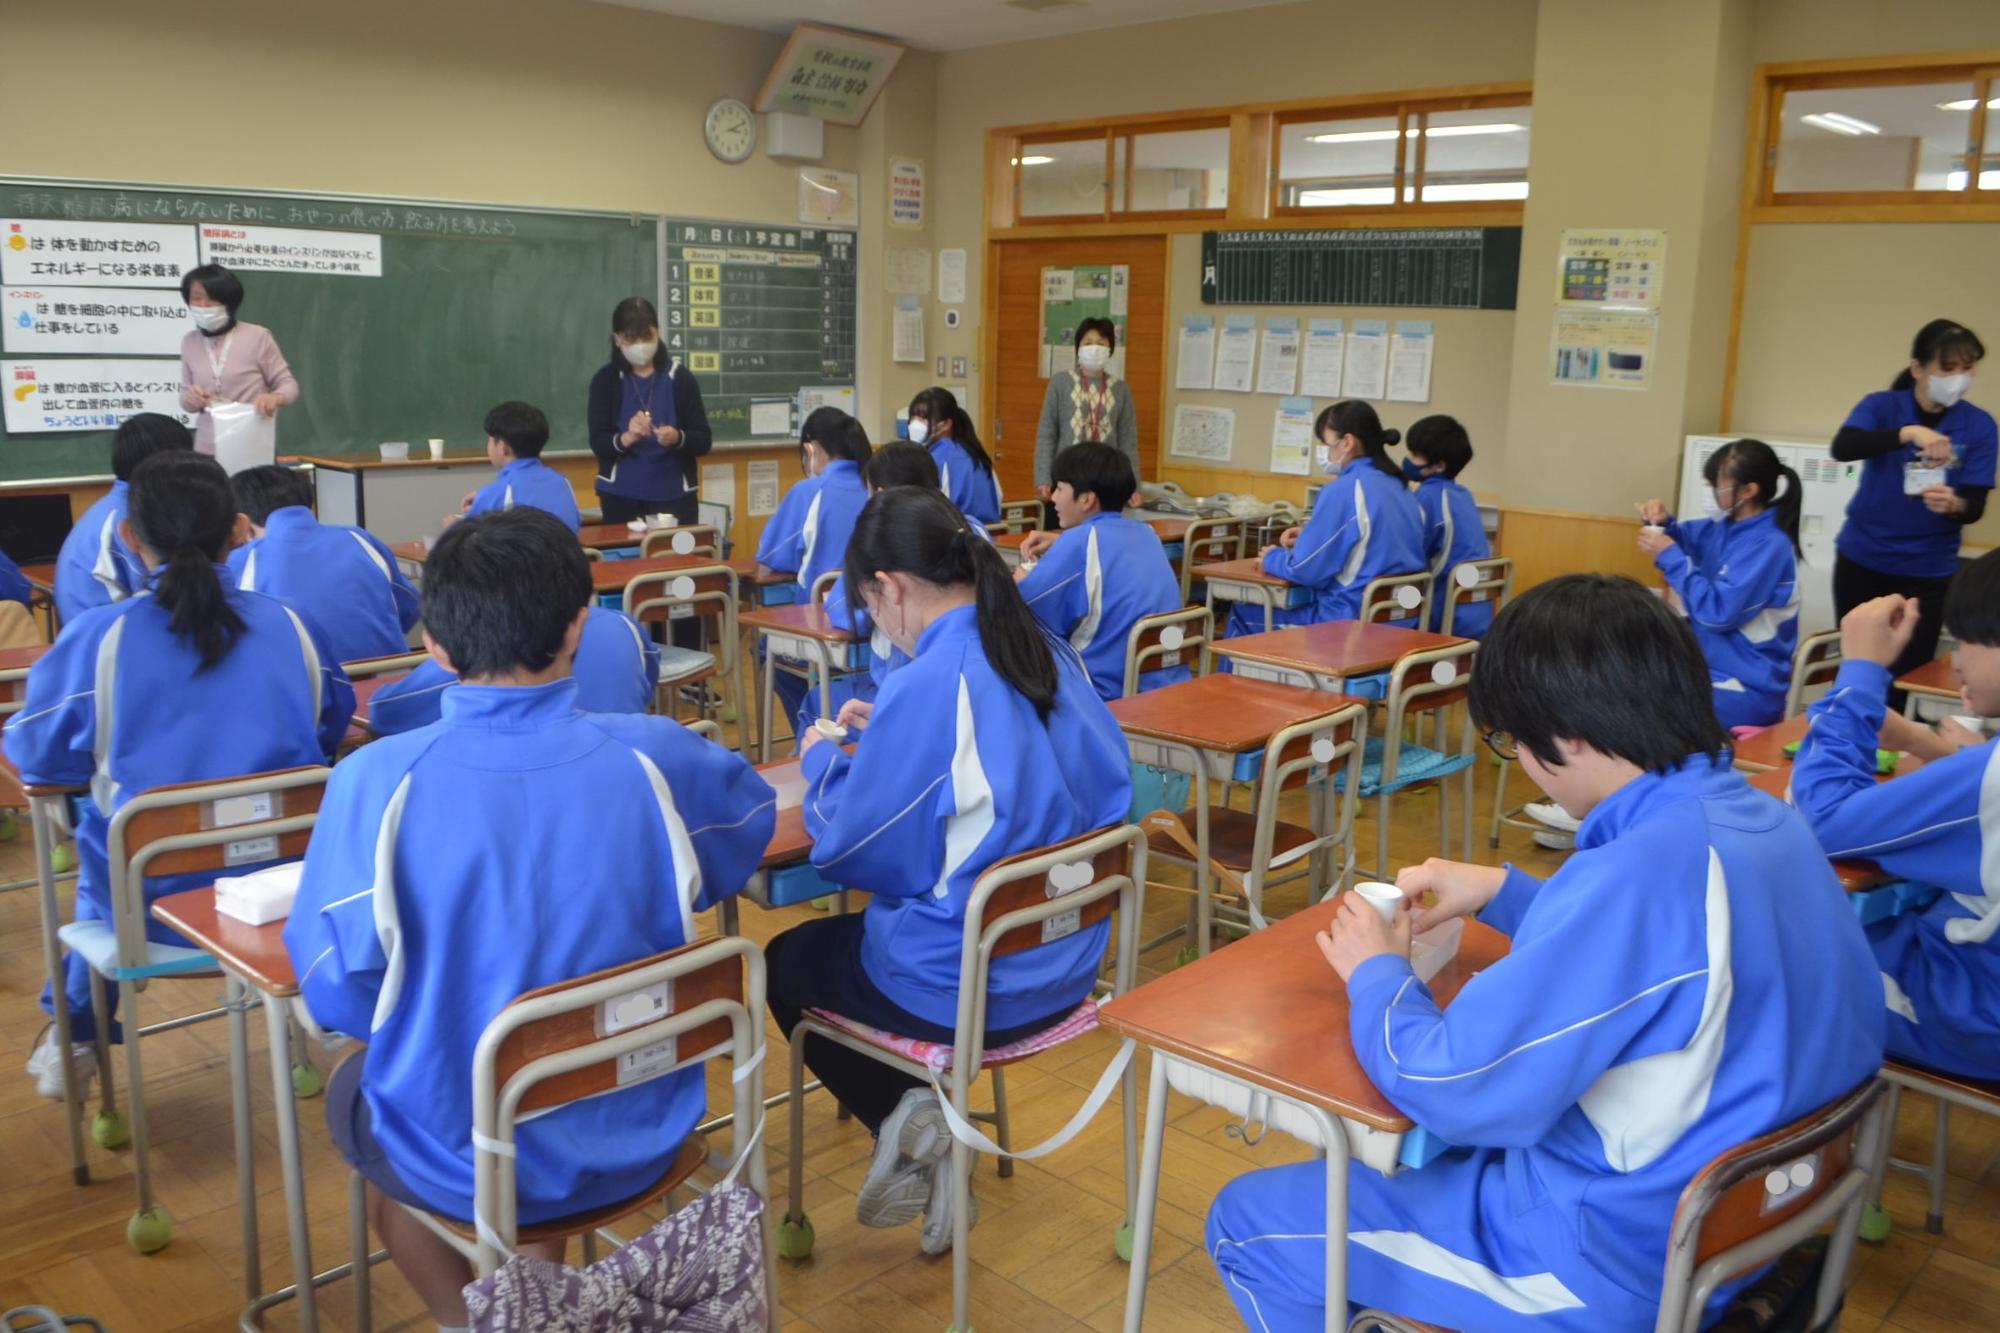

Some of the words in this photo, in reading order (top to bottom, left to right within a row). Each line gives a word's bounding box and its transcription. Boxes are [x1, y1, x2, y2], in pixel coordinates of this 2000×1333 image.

[31, 236, 46, 250] は
[51, 237, 161, 252] 体を動かすための
[30, 261, 181, 278] エネルギーになる栄養素
[672, 265, 679, 278] 1
[1203, 266, 1216, 285] 月
[670, 288, 680, 301] 2
[37, 303, 48, 314] は
[54, 303, 187, 319] 糖を細胞の中に取り込む
[671, 311, 681, 324] 3
[35, 321, 120, 335] 仕事をしている
[671, 334, 682, 347] 4
[38, 382, 49, 394] は
[54, 382, 181, 394] 糖が血管に入るとインスリ
[43, 399, 144, 411] 出して血管内の糖を
